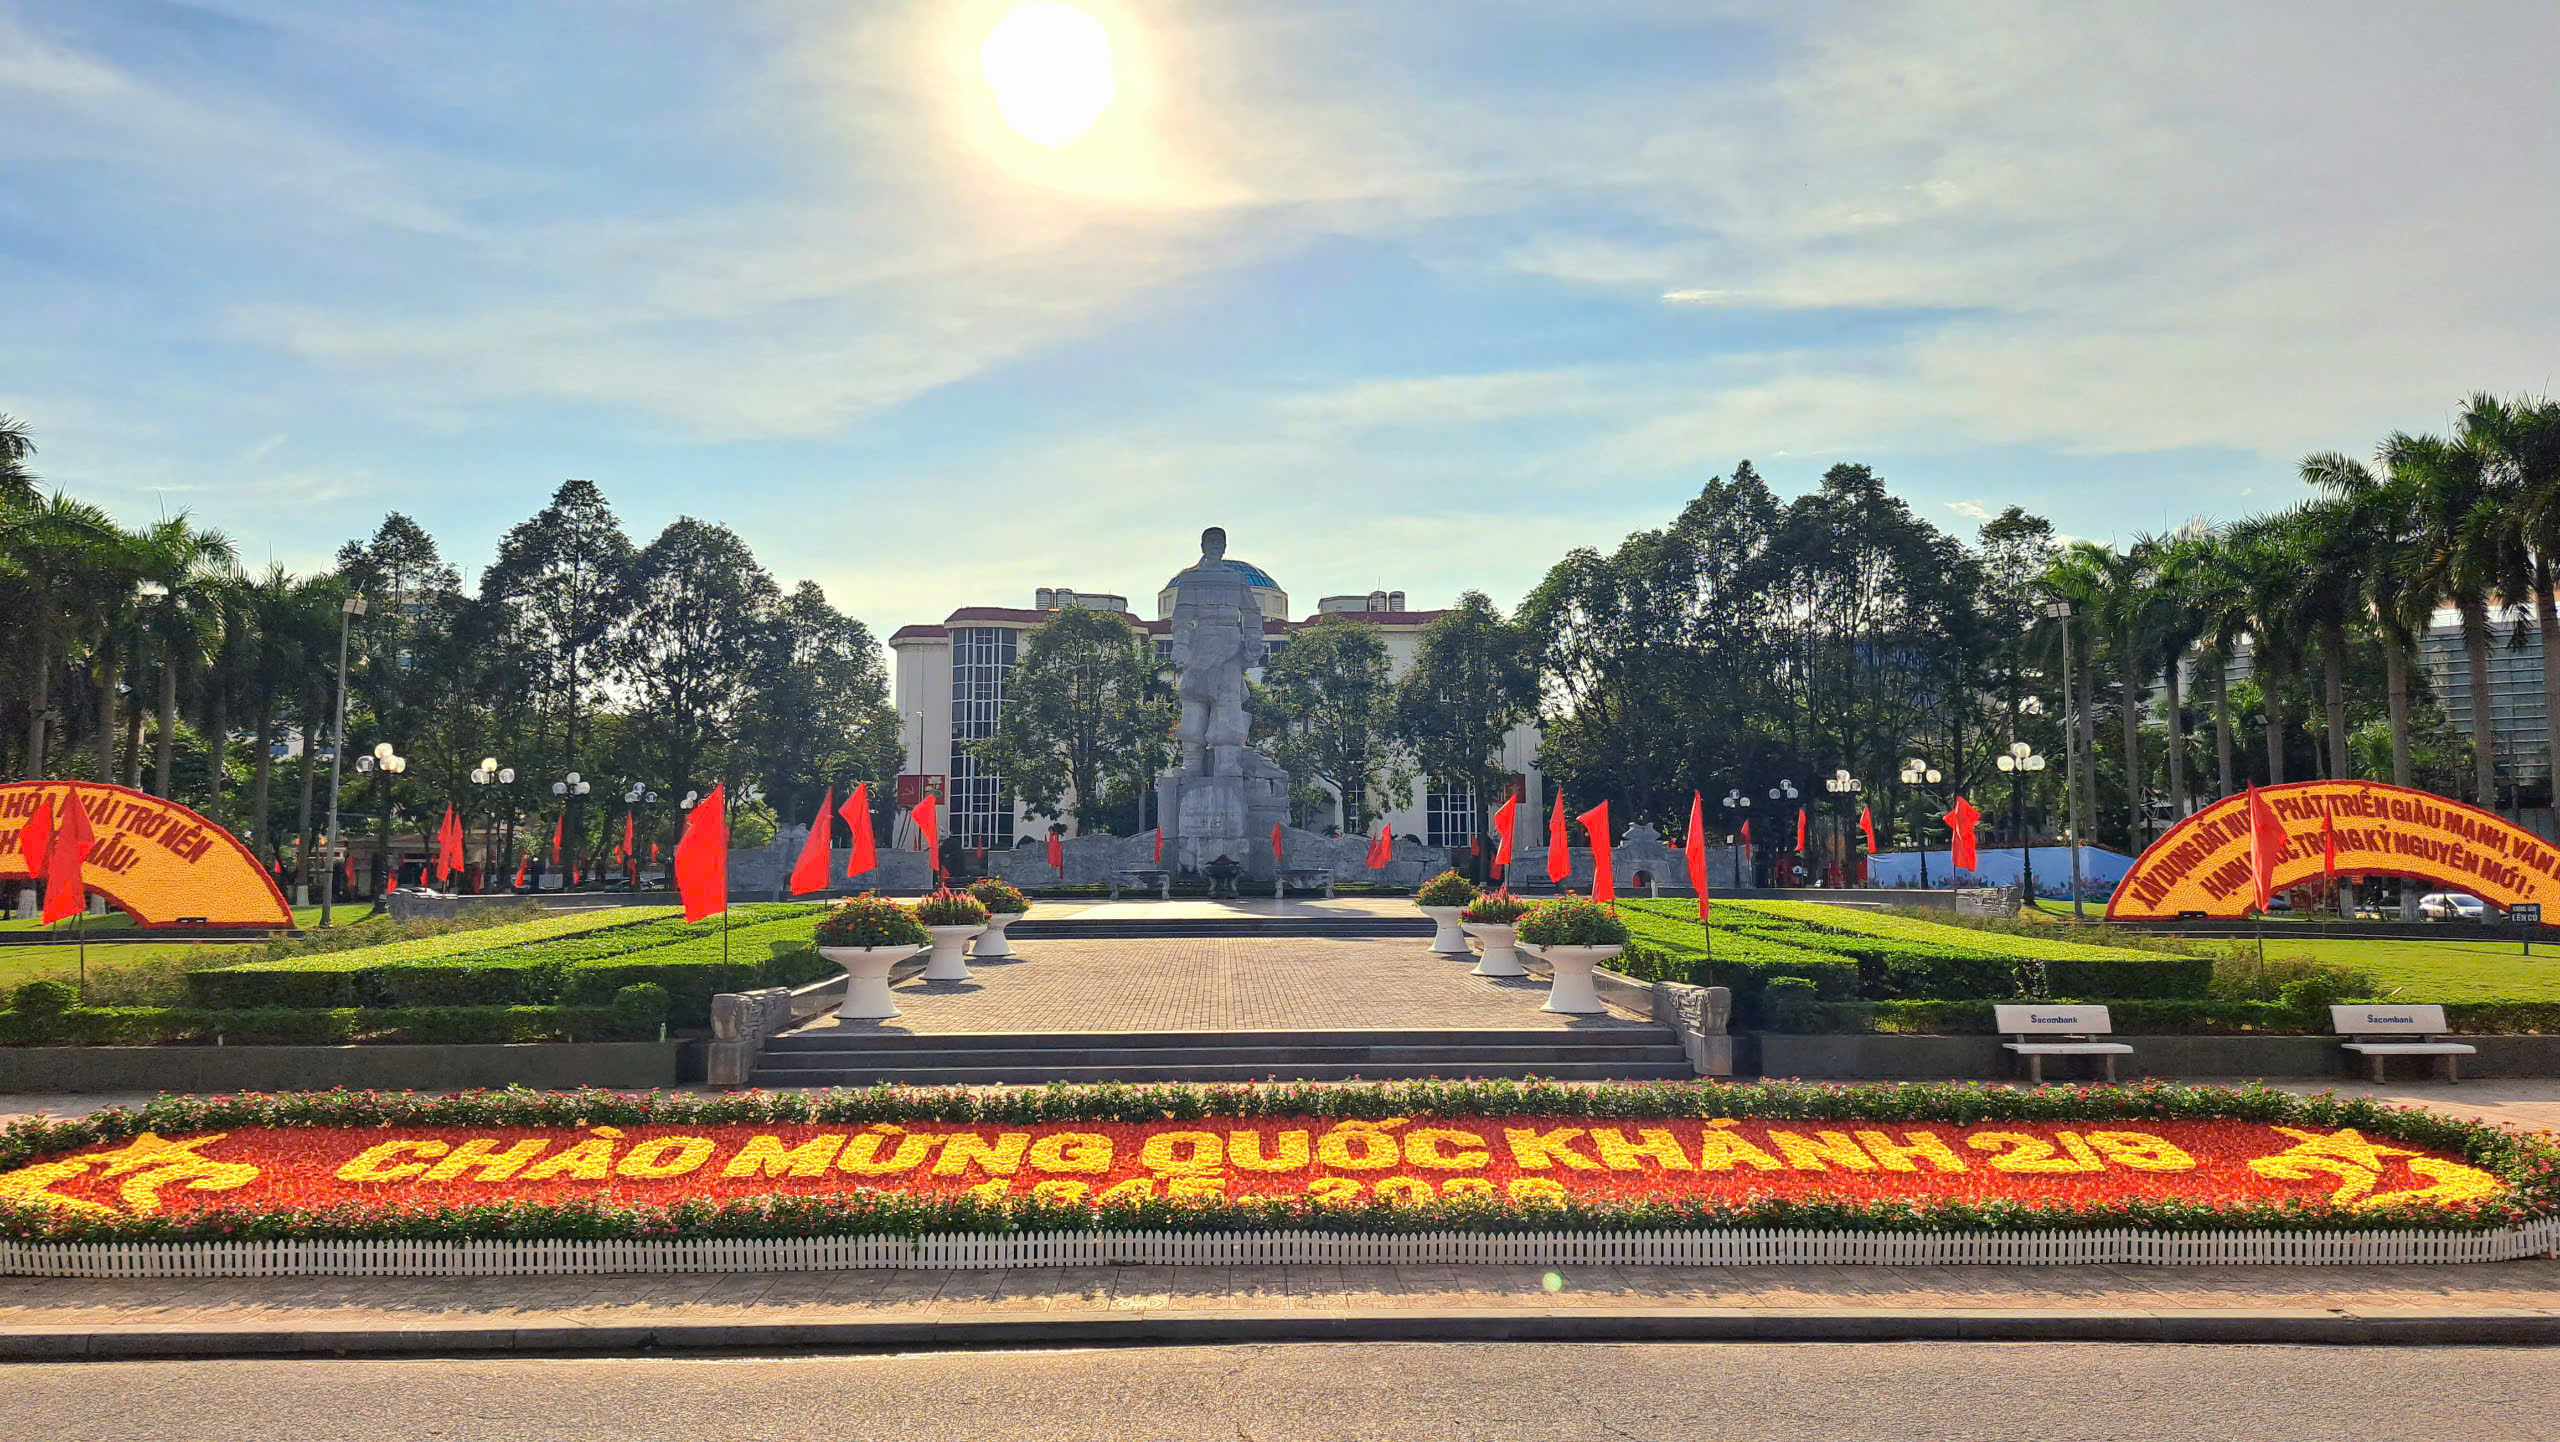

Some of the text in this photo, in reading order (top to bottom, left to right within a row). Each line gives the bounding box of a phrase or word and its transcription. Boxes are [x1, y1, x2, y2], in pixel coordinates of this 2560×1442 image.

[116, 805, 172, 838] TRỞ
[156, 820, 214, 864] NÊN
[2130, 872, 2169, 911] XÂY
[2152, 840, 2204, 887] DỰNG
[2191, 817, 2232, 854] ĐẤT
[2272, 790, 2324, 821] PHÁT
[2325, 786, 2390, 820] TRIỂN
[2391, 798, 2441, 828] GIÀU
[2513, 837, 2555, 874] VĂN
[2200, 857, 2252, 901] HẠNH
[2292, 829, 2366, 858] TRONG
[2363, 824, 2391, 853] KỶ
[2394, 832, 2479, 874] NGUYÊN
[2480, 857, 2535, 899] MỚI!
[2031, 1014, 2078, 1024] Sacombank
[2367, 1014, 2414, 1024] Sacombank
[334, 1125, 716, 1182] CHÀO
[721, 1123, 1114, 1177] MỪNG
[1142, 1118, 1490, 1177] QUỐC
[1504, 1117, 1969, 1173] KHÁNH
